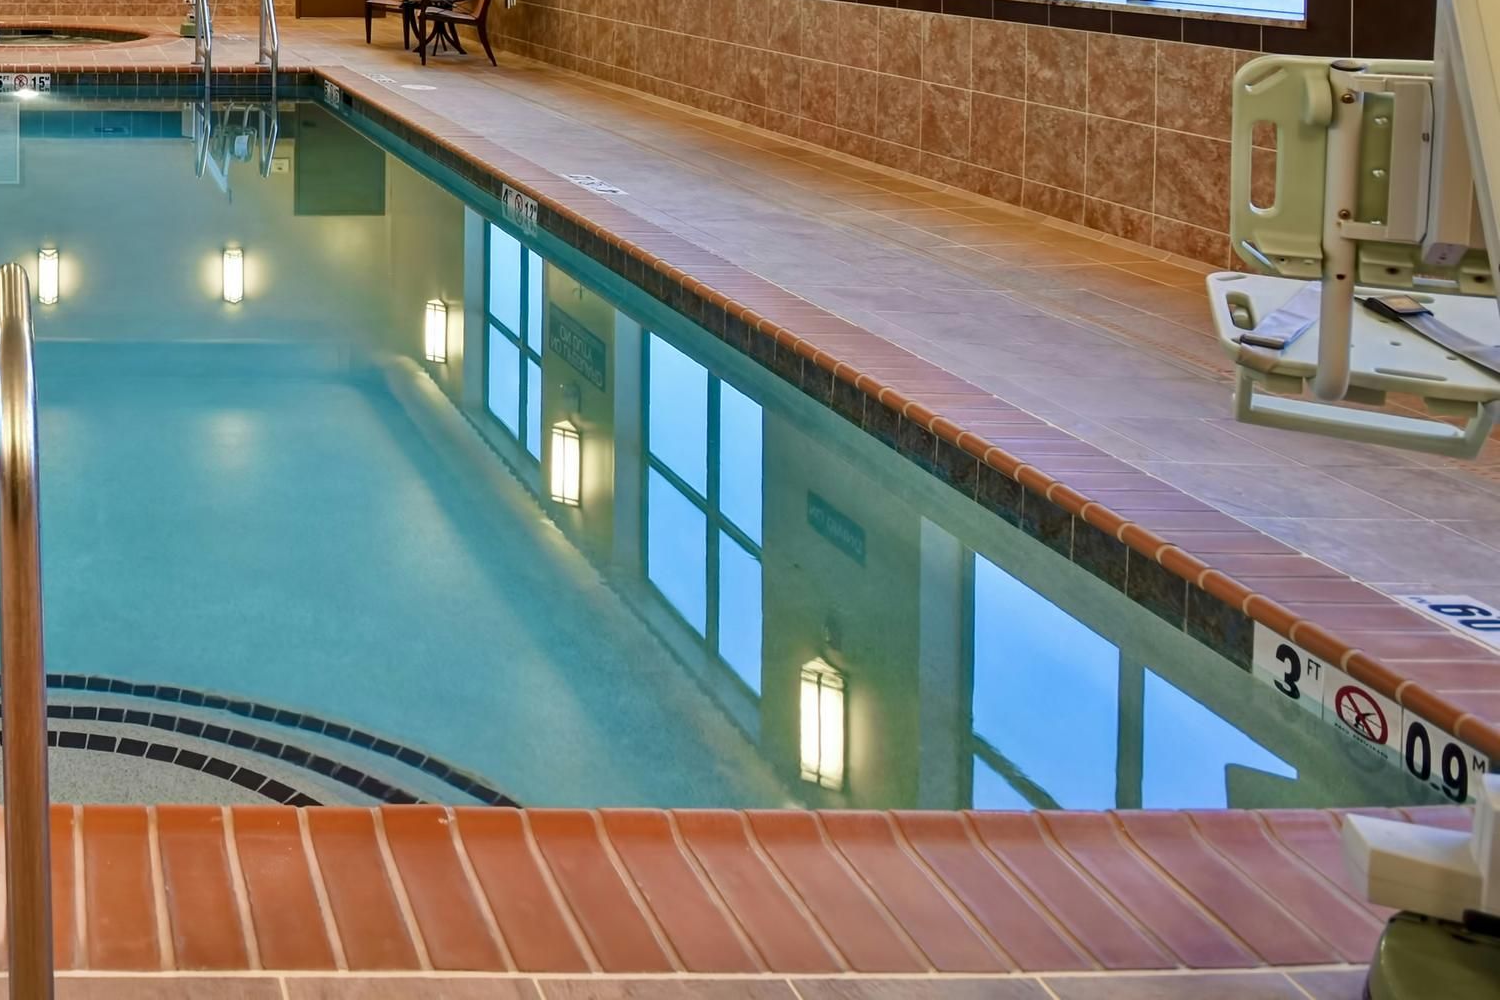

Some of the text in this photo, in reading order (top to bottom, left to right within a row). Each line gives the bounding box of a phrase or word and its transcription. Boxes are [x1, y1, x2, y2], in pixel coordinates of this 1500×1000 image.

[1273, 643, 1302, 700] 3
[1306, 658, 1322, 681] FT
[1404, 720, 1469, 804] 0.9
[1471, 754, 1486, 774] M
